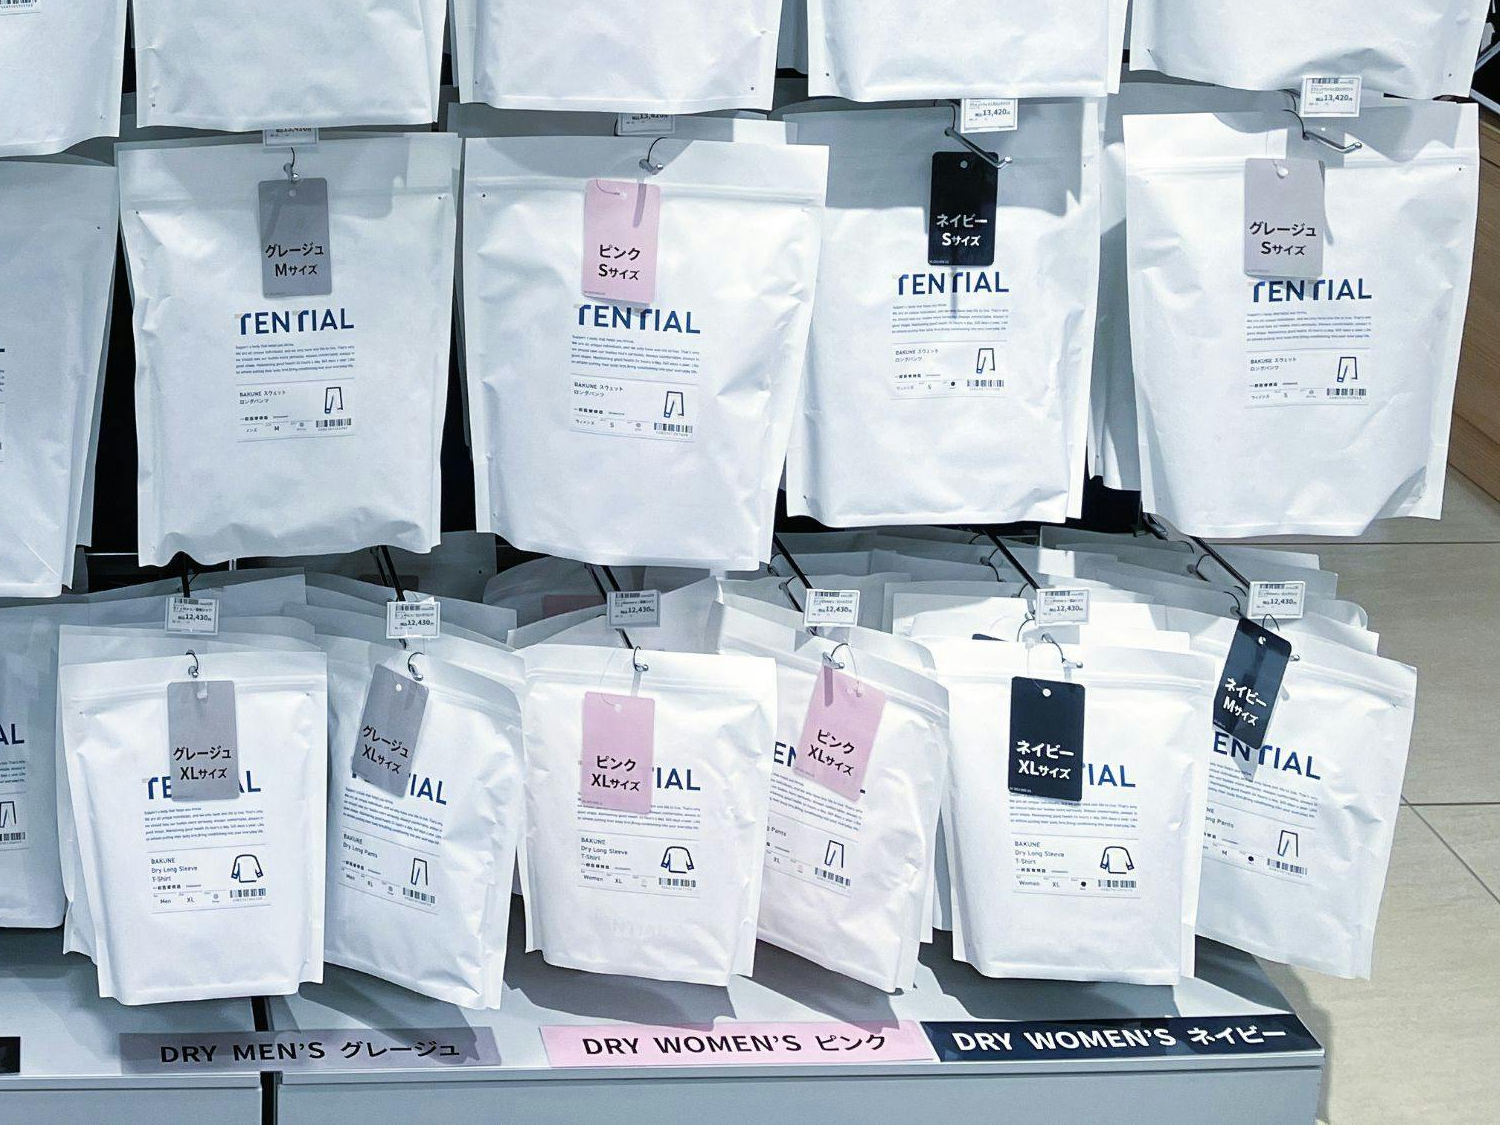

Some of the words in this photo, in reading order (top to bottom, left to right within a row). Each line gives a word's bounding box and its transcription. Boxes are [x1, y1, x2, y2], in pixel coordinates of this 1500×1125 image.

[936, 213, 988, 228] ネイビー
[1249, 221, 1317, 237] グレージュ
[265, 242, 325, 258] グレージュ
[942, 232, 981, 247] Sサイズ
[1261, 241, 1306, 256] Sサイズ
[599, 243, 641, 261] ピンク
[275, 263, 317, 277] Mサイズ
[598, 263, 640, 281] Sサイズ
[892, 272, 1010, 296] TENTIAL
[1247, 278, 1373, 303] TENTIAL
[235, 308, 354, 336] TENTIAL
[573, 303, 701, 335] TENTIAL
[1224, 677, 1267, 708] ネイビー
[1223, 697, 1258, 728] Mサイズ
[363, 724, 409, 759] グレージュ
[817, 729, 855, 755] ピンク
[1016, 740, 1074, 759] ネイビー
[173, 746, 232, 762] グレージュ
[362, 744, 401, 775] XLサイズ
[596, 755, 637, 773] ピンク
[808, 745, 854, 777] XLサイズ
[1213, 730, 1321, 781] ENTIAL
[180, 767, 228, 781] XLサイズ
[1018, 759, 1071, 780] XLサイズ
[591, 774, 641, 792] XLサイズ
[179, 864, 198, 872] Sleeve
[582, 1035, 640, 1056] DRY
[816, 1031, 887, 1053] ピンク
[952, 1031, 1011, 1053] DRY
[1189, 1025, 1287, 1047] ネイビー
[161, 1045, 217, 1064] DRY
[341, 1040, 461, 1059] グレージュ
